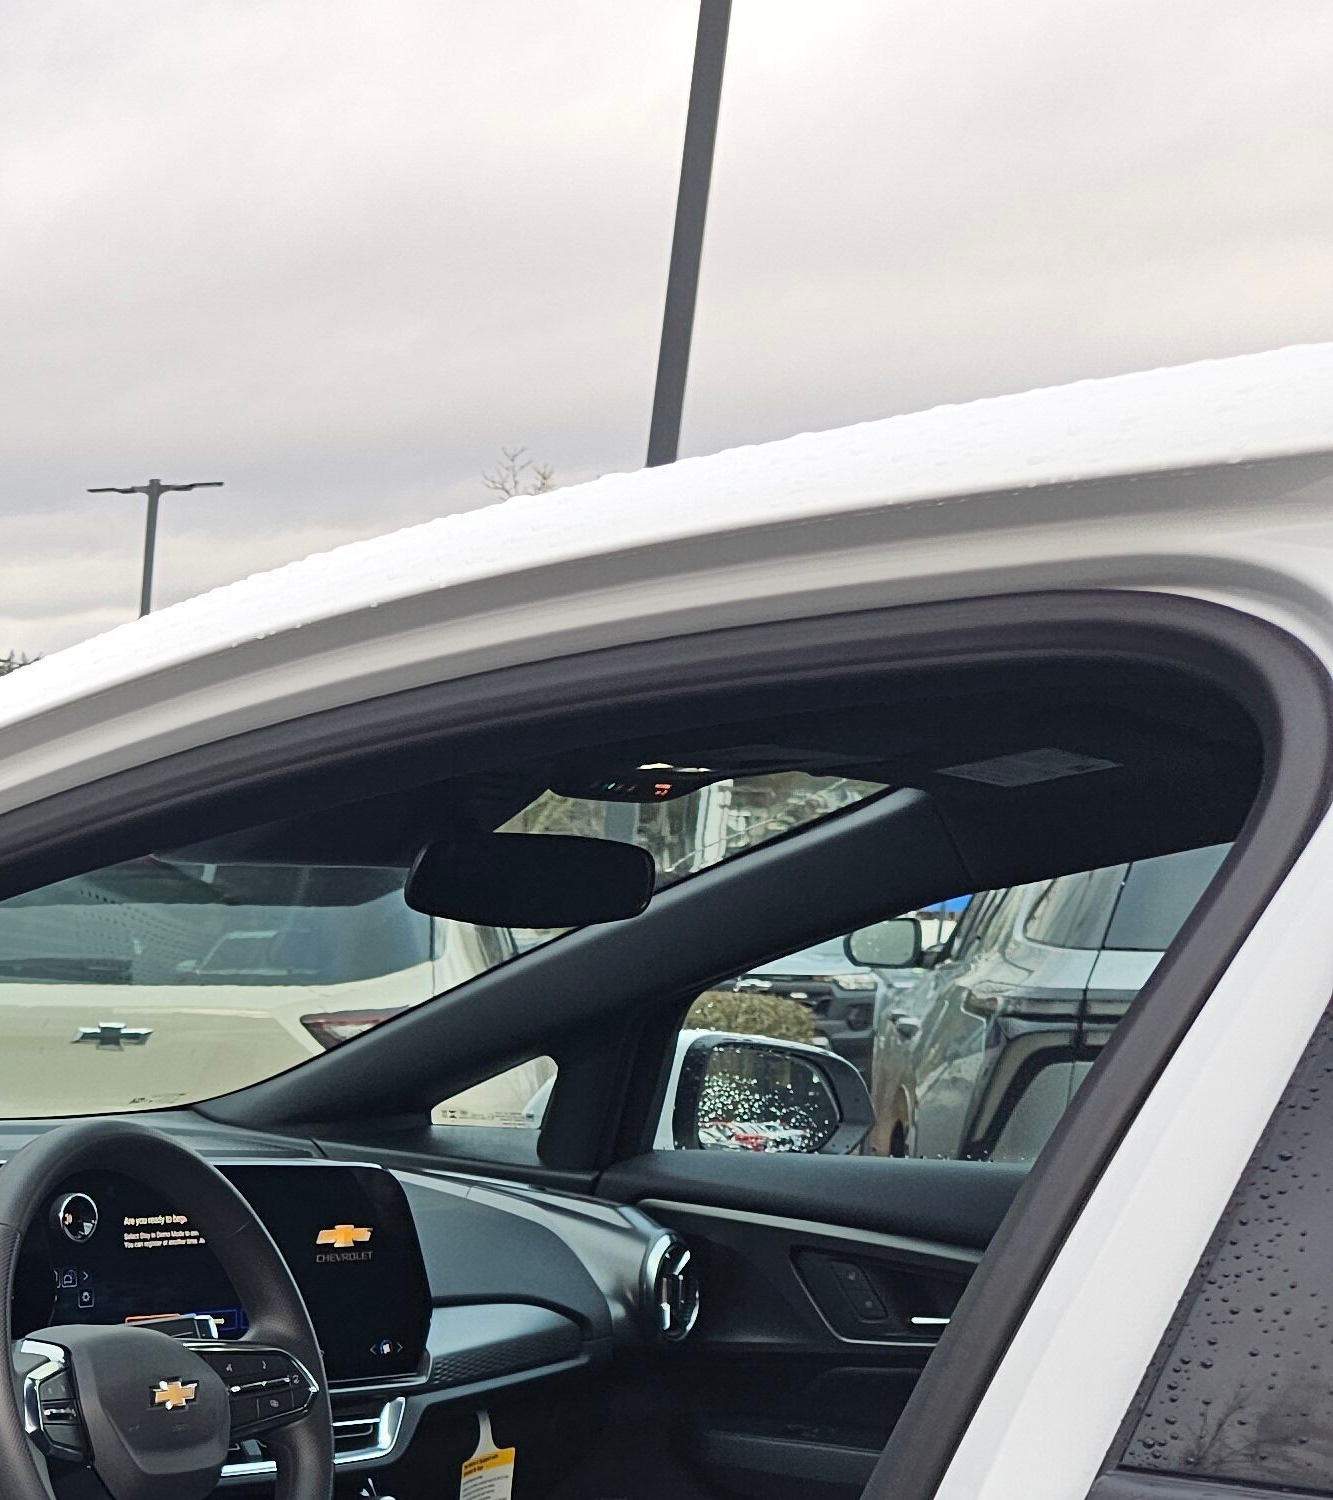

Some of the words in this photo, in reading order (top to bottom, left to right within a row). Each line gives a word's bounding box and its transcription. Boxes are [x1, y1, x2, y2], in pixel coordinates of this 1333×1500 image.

[124, 1217, 135, 1226] Are
[136, 1217, 148, 1226] you
[148, 1215, 165, 1226] ready
[165, 1215, 173, 1224] to
[316, 1251, 373, 1263] CHEVROLET
